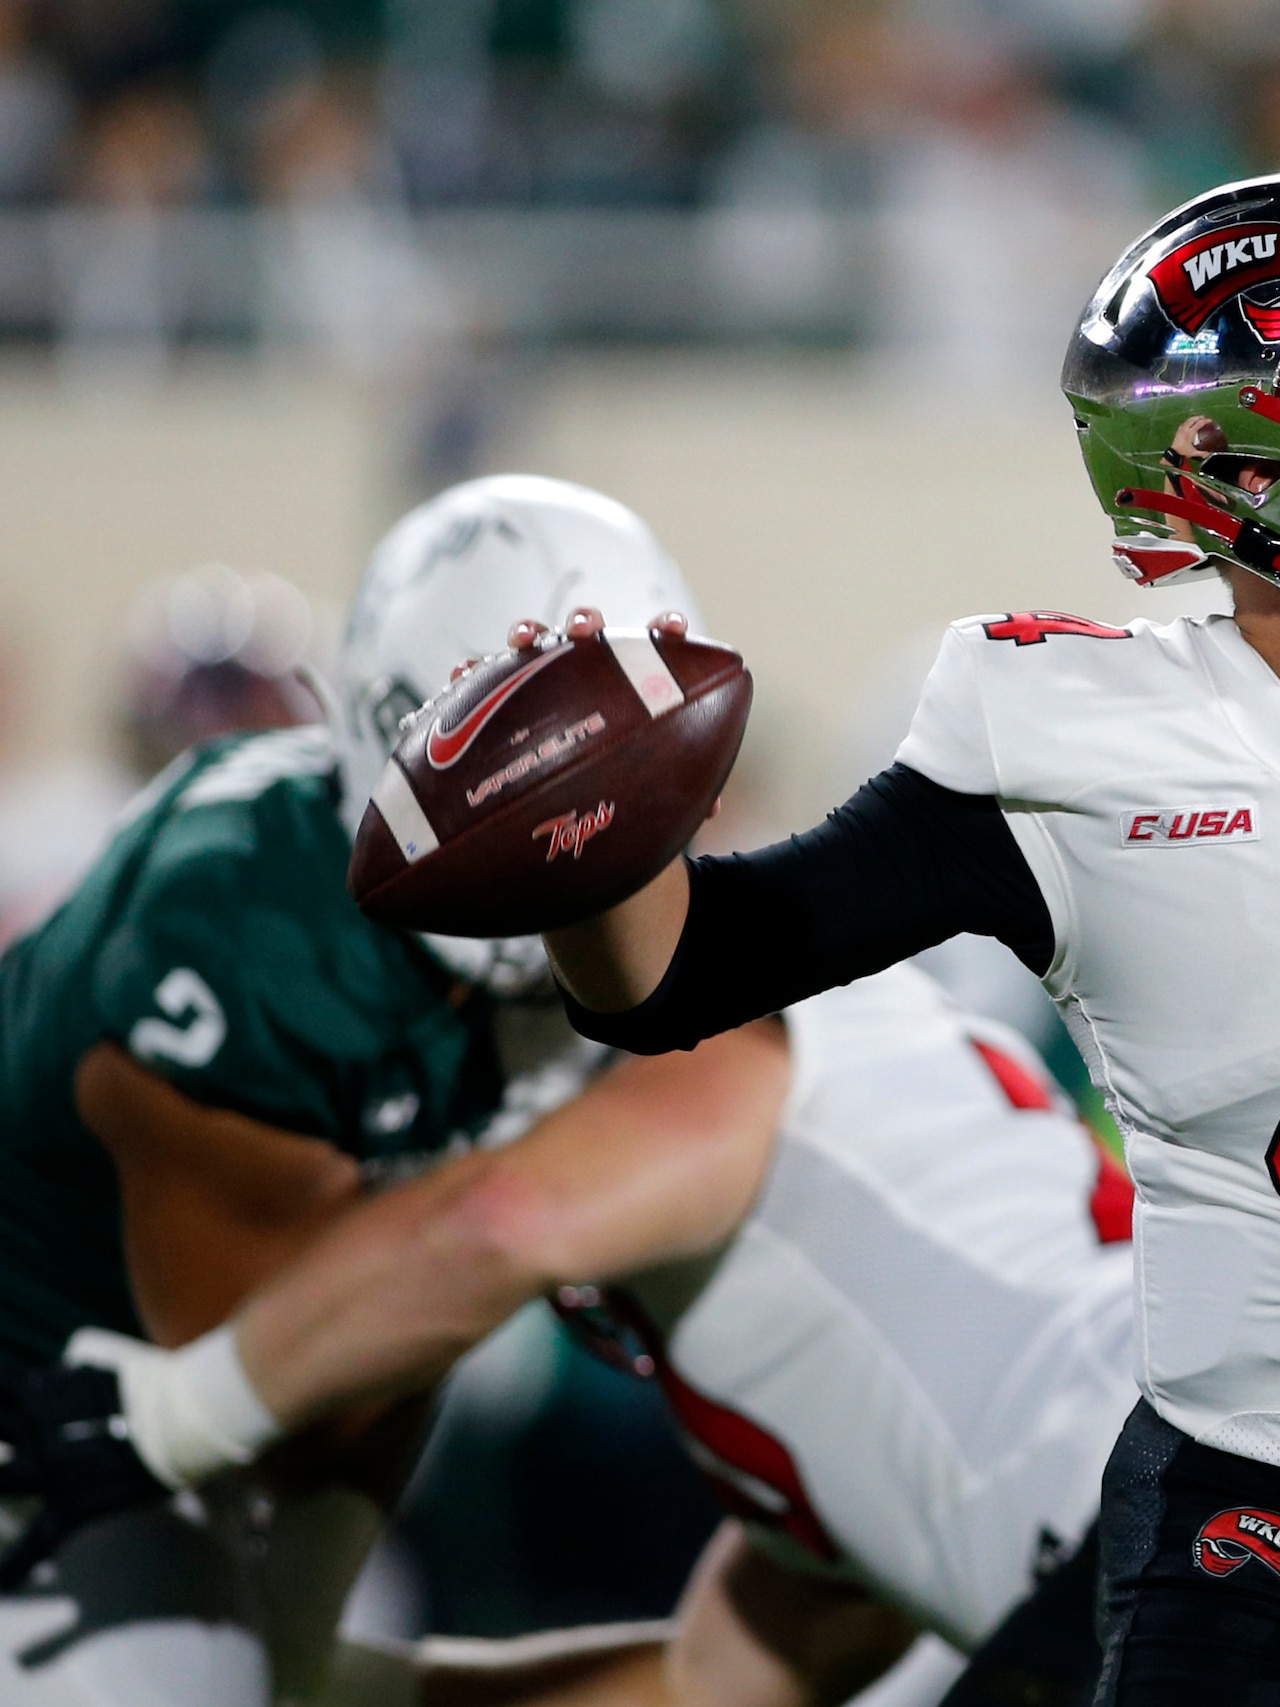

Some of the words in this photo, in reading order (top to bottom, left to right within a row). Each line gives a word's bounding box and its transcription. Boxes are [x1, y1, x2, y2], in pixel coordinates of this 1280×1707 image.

[1182, 233, 1278, 291] WKU
[538, 711, 605, 760] ELITE
[532, 800, 615, 862] Tops
[130, 966, 227, 1069] 2
